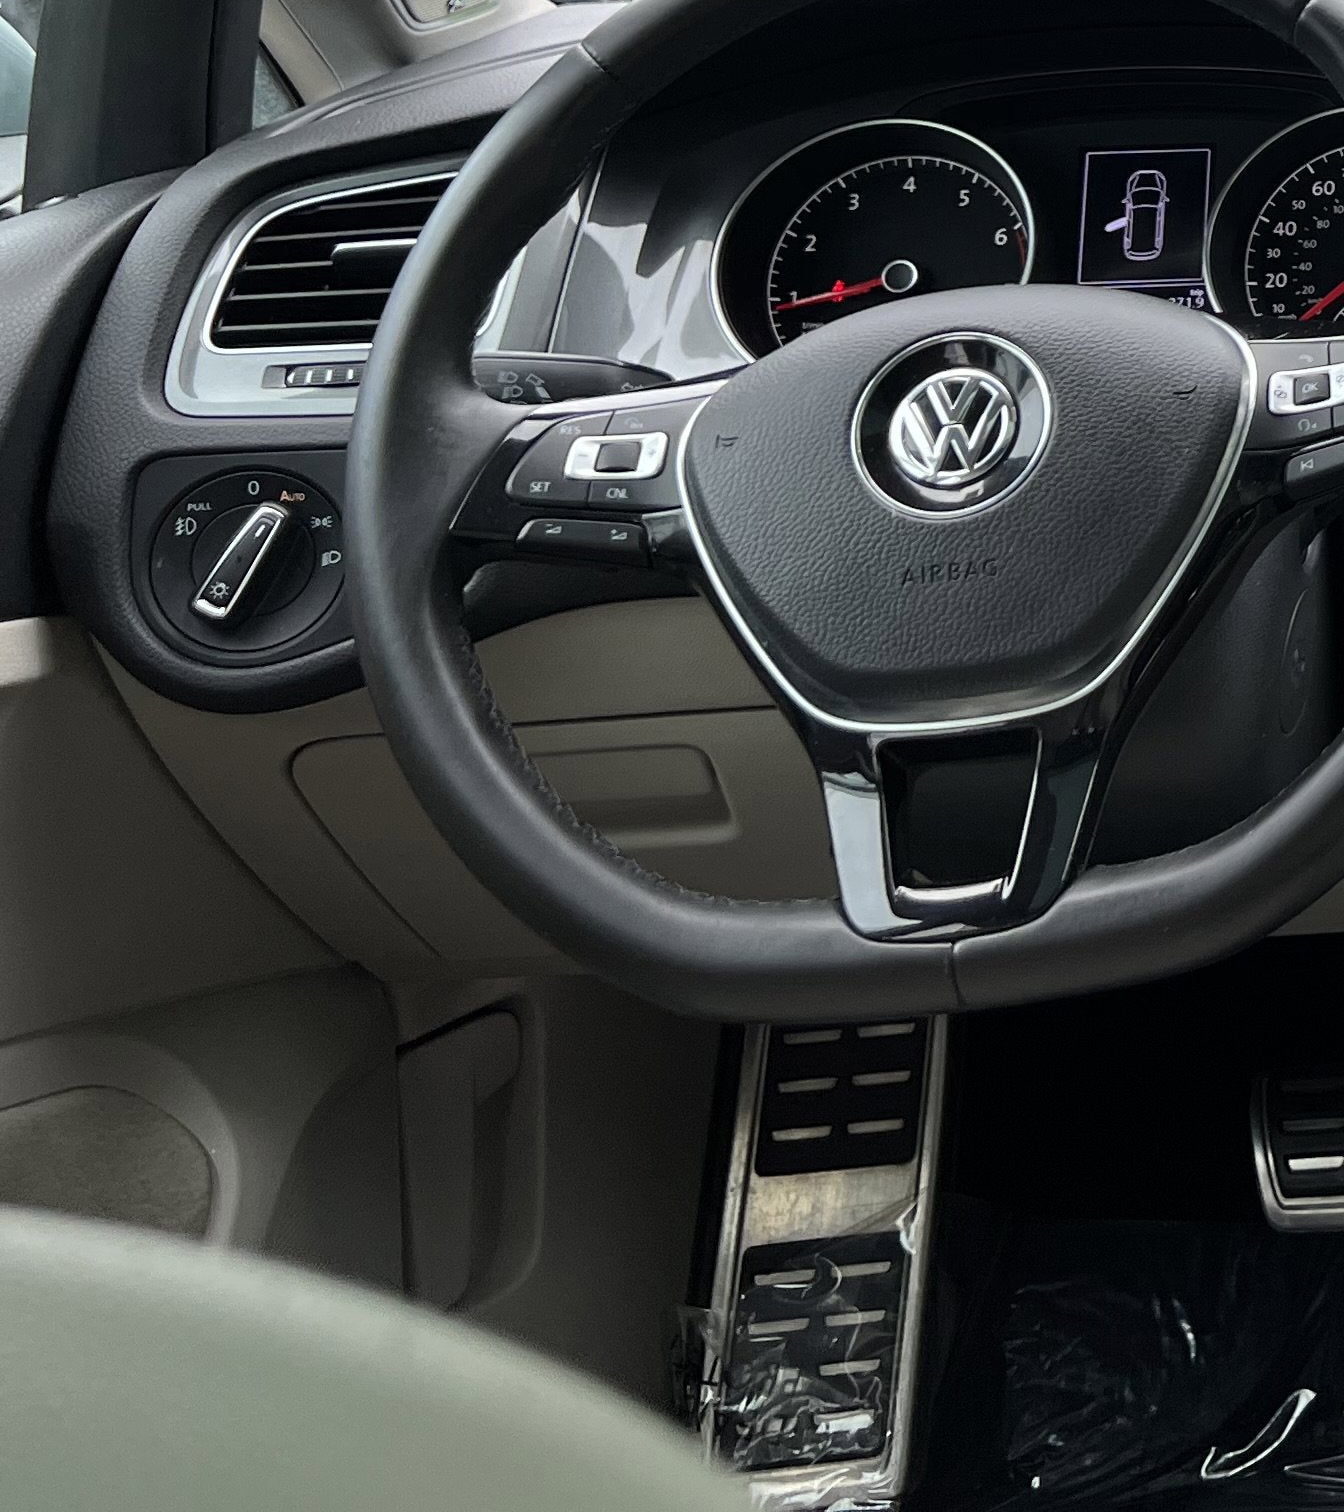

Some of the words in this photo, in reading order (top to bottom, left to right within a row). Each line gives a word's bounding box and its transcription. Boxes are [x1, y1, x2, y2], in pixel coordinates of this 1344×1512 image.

[902, 176, 917, 193] 4
[1311, 180, 1336, 196] 60
[848, 193, 860, 211] 3
[958, 189, 970, 207] 5
[1291, 200, 1306, 210] 50
[1273, 221, 1298, 236] 40
[1316, 219, 1330, 229] 80
[994, 228, 1008, 246] 6
[804, 234, 817, 252] 2
[1303, 239, 1318, 249] 60
[1266, 248, 1281, 258] 30
[1299, 262, 1313, 272] 40
[1265, 272, 1288, 288] 20
[1302, 285, 1316, 295] 20
[1272, 303, 1285, 313] 10
[1302, 382, 1319, 393] OK
[559, 425, 582, 435] RES
[529, 481, 551, 493] SET
[605, 488, 629, 499] CNL
[187, 503, 212, 512] PULL
[901, 558, 1000, 586] AIRBAG
